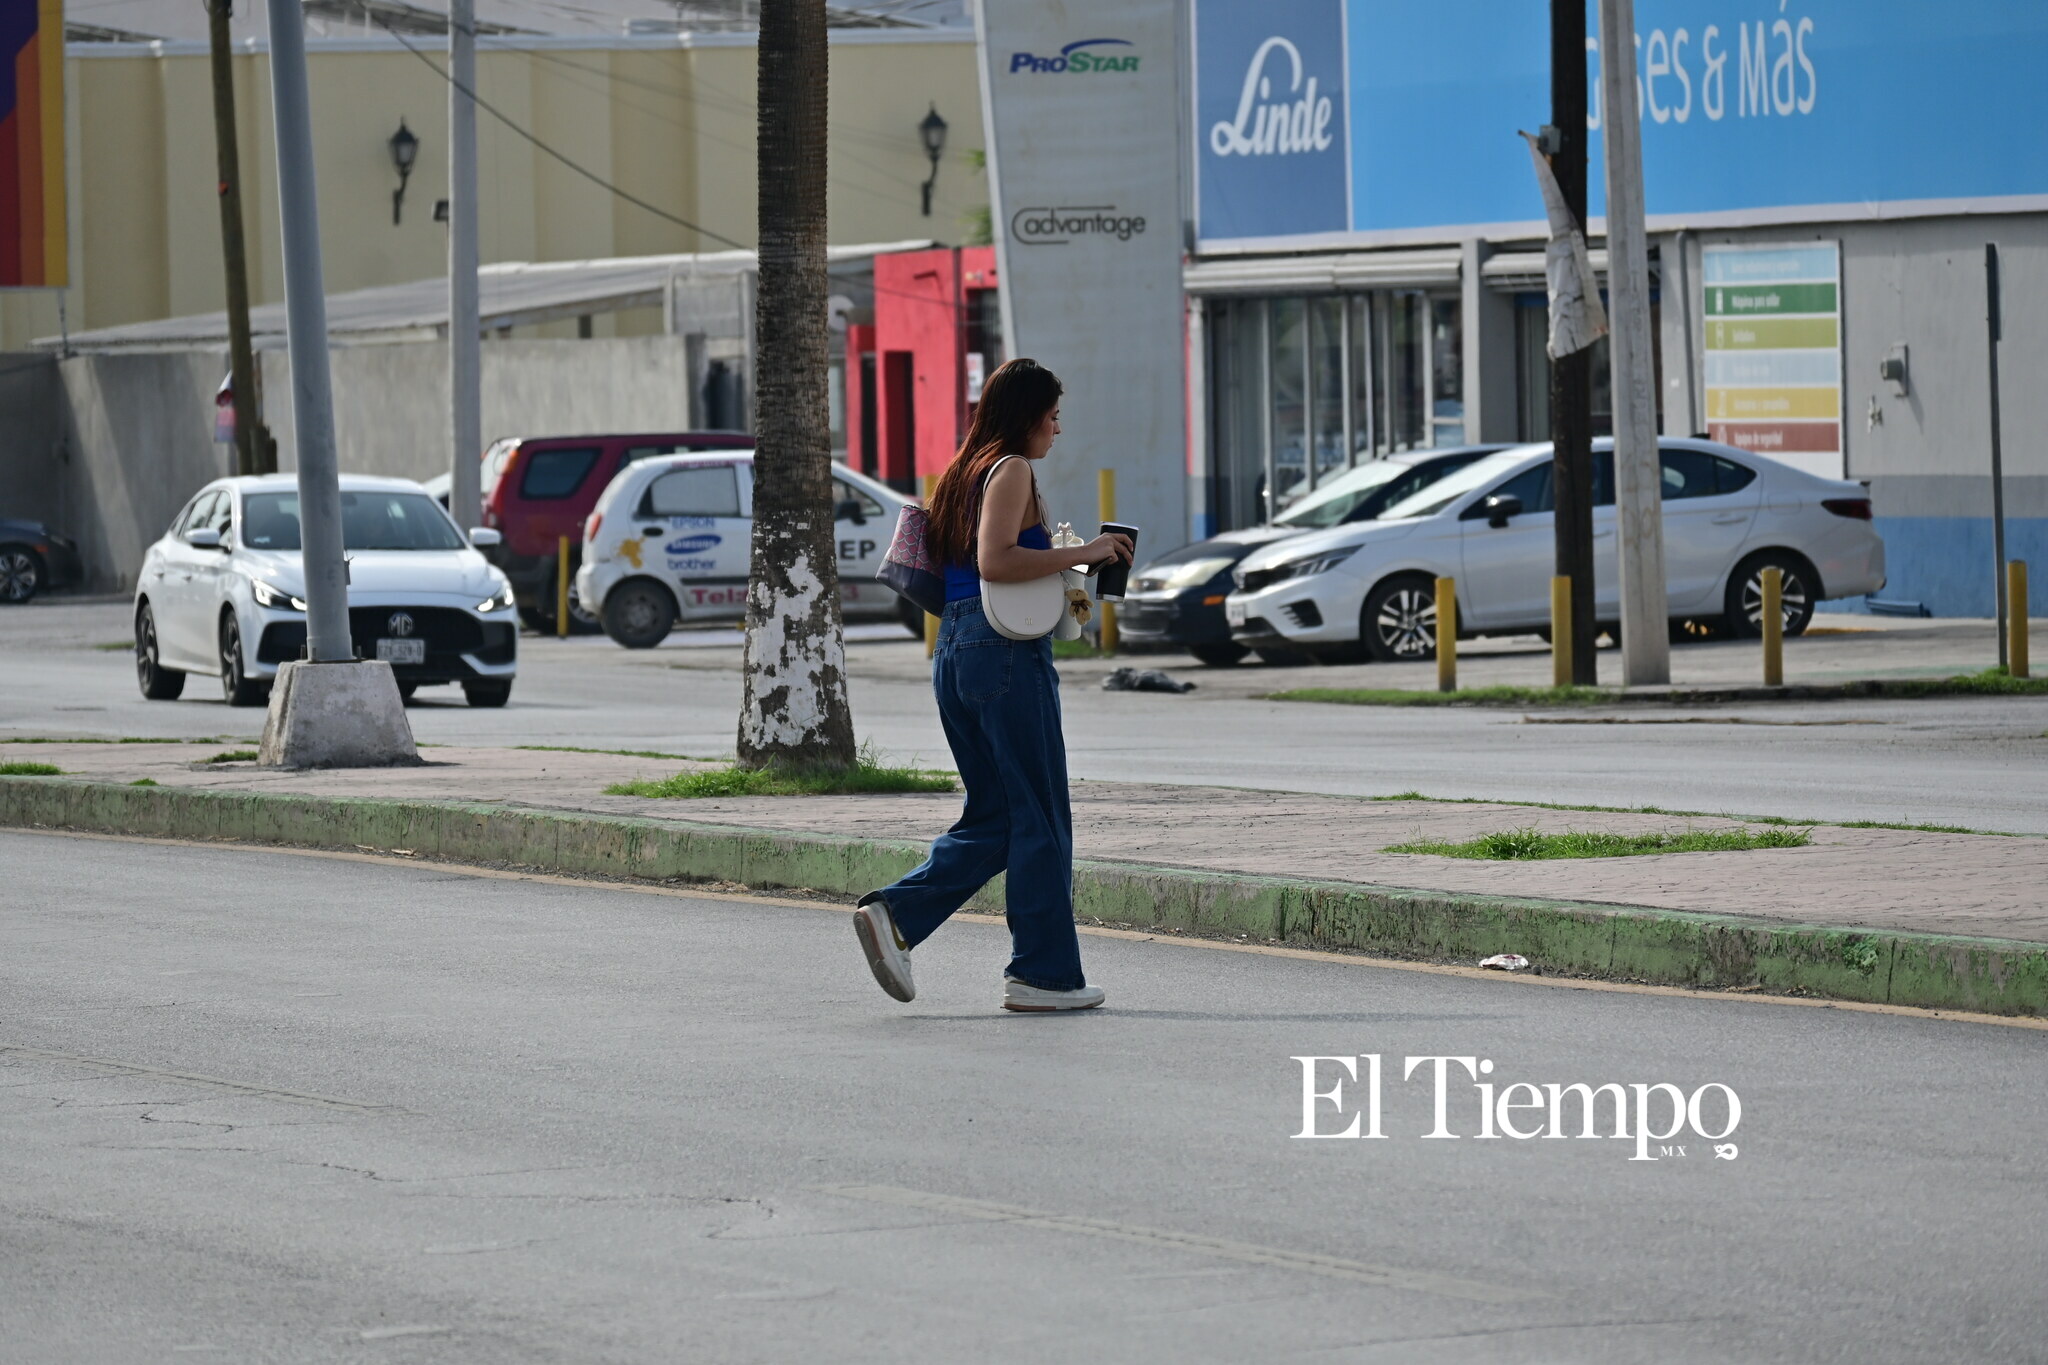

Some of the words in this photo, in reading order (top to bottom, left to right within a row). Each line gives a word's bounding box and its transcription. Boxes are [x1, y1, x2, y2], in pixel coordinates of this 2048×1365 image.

[1210, 36, 1333, 157] Linde
[1703, 24, 1727, 121] &
[1023, 207, 1146, 242] advantage
